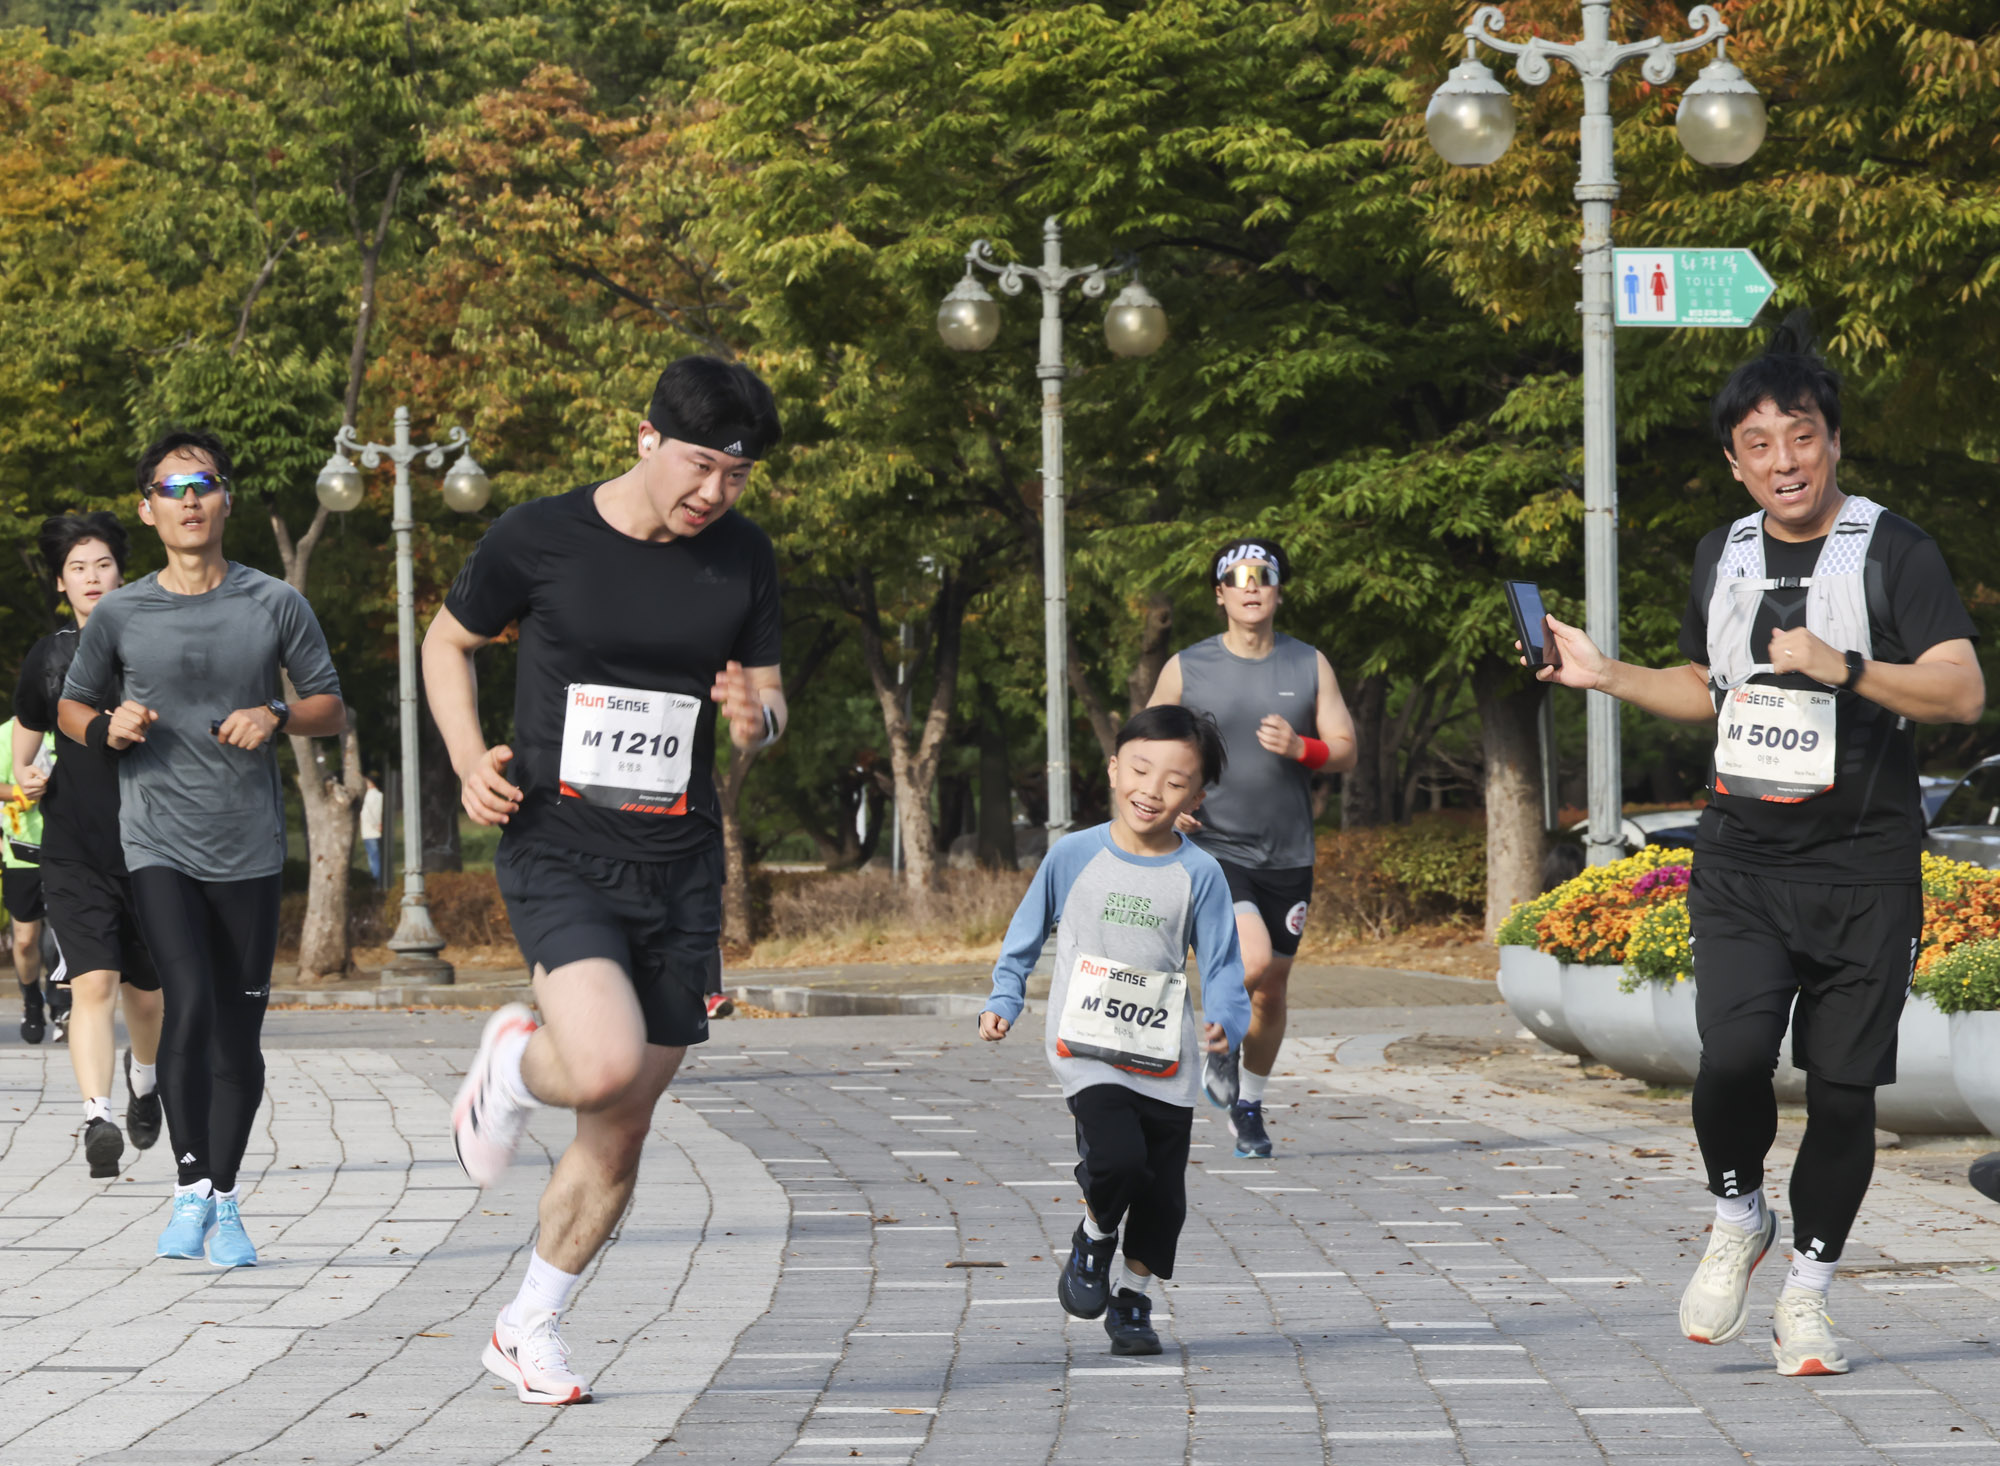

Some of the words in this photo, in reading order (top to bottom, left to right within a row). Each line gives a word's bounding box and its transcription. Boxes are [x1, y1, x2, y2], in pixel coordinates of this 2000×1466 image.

[1685, 276, 1734, 288] TOILET
[575, 692, 605, 708] Run
[1810, 696, 1830, 706] 5km
[582, 730, 602, 747] M
[611, 731, 679, 758] 1210
[1727, 724, 1743, 741] M
[1747, 724, 1819, 752] 5009
[1105, 891, 1152, 912] SWISS
[1101, 907, 1160, 929] MILITARY
[1080, 960, 1108, 977] Run
[1081, 995, 1101, 1012] M
[1104, 998, 1168, 1029] 5002
